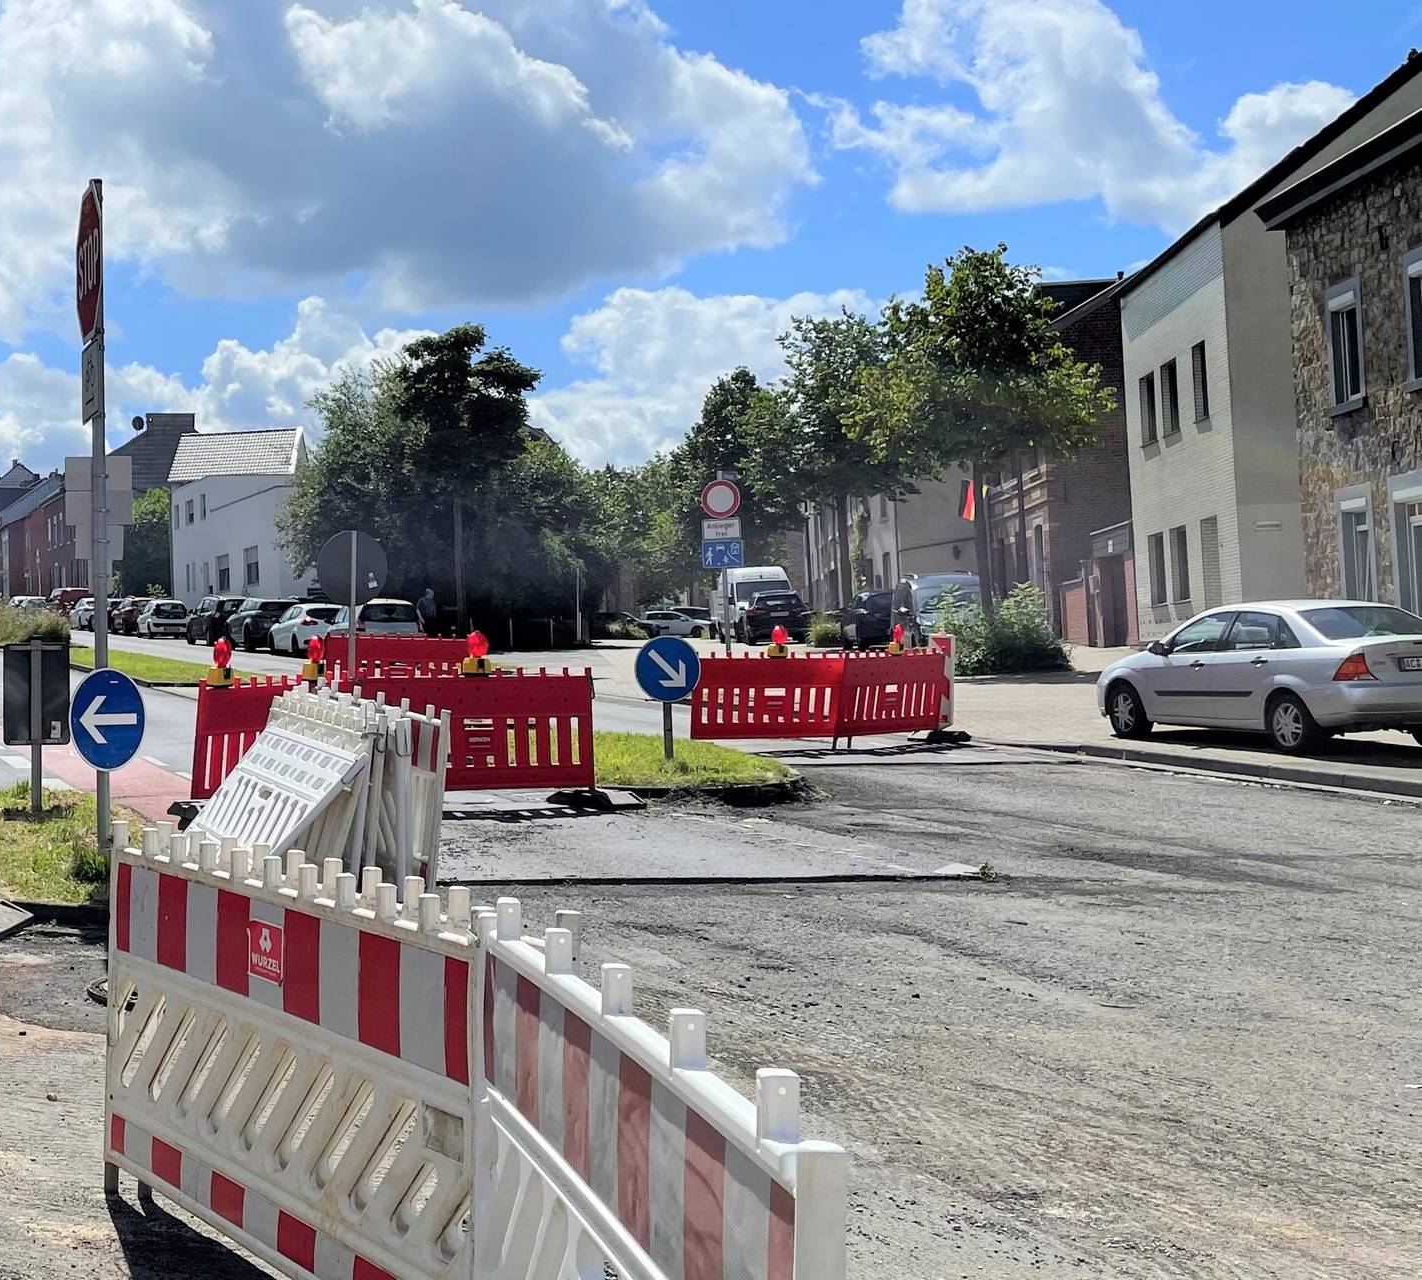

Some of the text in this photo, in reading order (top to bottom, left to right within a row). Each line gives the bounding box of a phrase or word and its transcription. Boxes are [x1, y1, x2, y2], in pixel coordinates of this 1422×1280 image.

[79, 228, 98, 301] STOP
[706, 522, 736, 530] Anlieger
[251, 951, 280, 973] WURZEL
